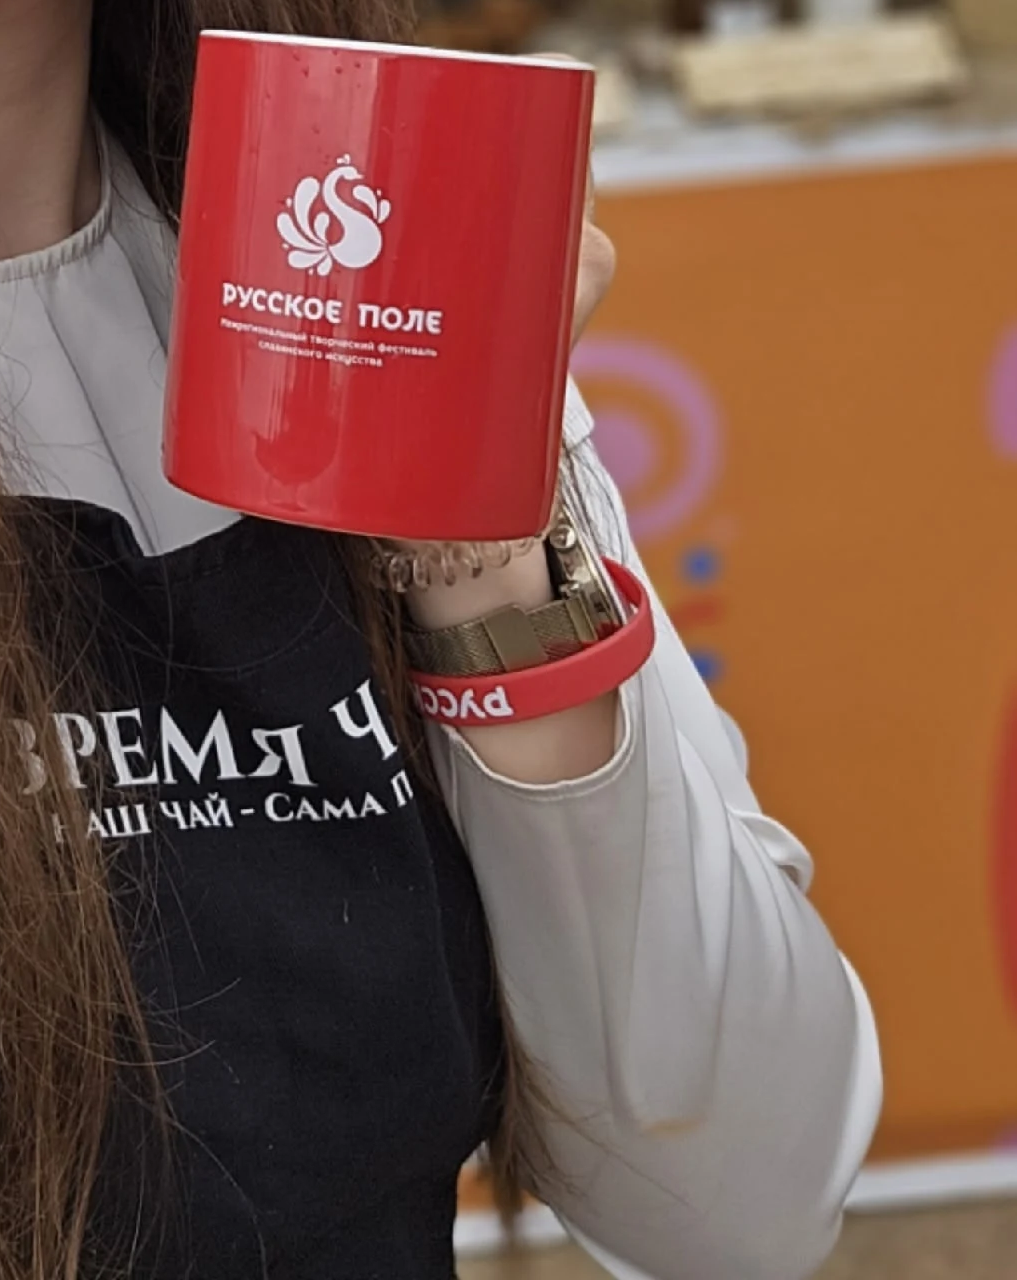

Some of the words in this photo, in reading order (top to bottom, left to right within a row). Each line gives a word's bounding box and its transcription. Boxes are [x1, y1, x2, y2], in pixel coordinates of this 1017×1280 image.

[222, 282, 343, 324] РУССКОЕ
[358, 303, 443, 334] ПОЛЕ
[310, 334, 375, 352] творческий
[377, 342, 438, 357] фестиваль
[325, 352, 383, 367] искусства
[418, 685, 514, 719] РУСС
[160, 792, 233, 830] ЧАЙ
